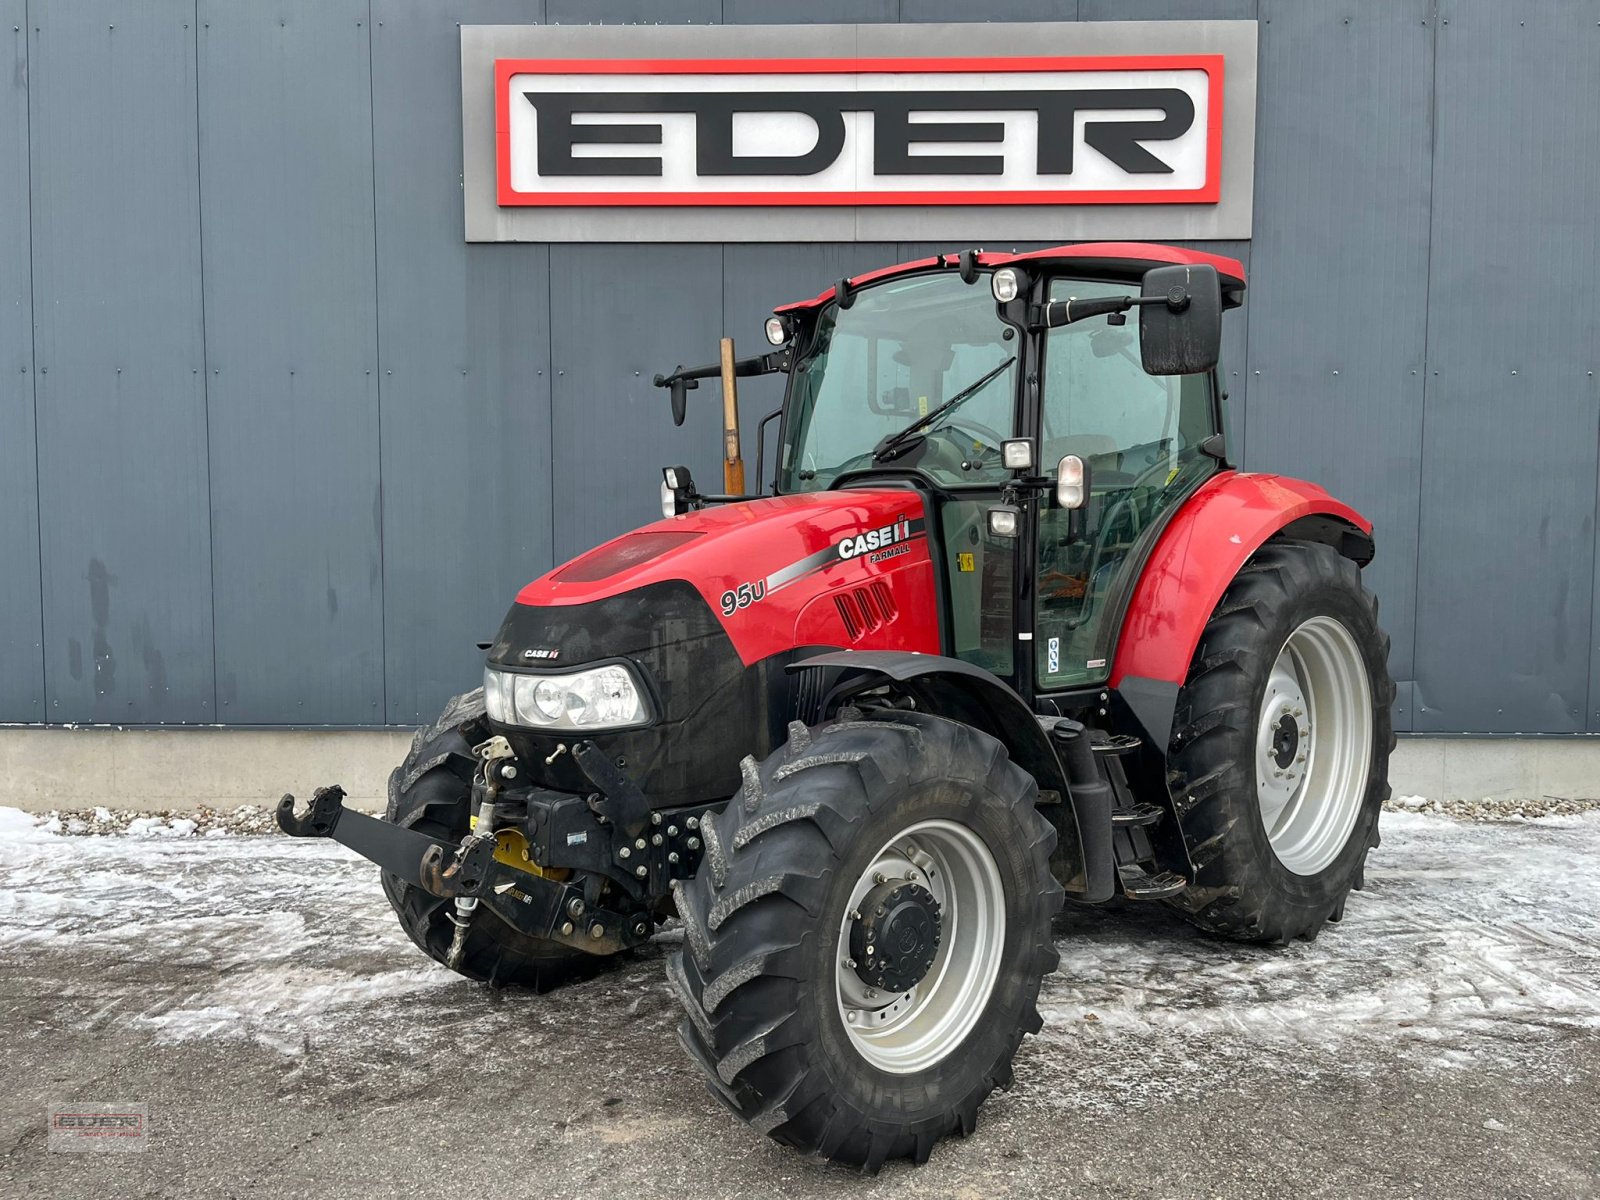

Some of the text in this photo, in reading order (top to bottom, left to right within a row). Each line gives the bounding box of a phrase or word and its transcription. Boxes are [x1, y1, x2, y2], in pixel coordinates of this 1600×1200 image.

[522, 88, 1195, 176] EDER
[838, 528, 892, 559] CASE
[869, 543, 911, 564] FARMALL
[720, 579, 765, 617] 95U
[524, 649, 549, 658] CASE
